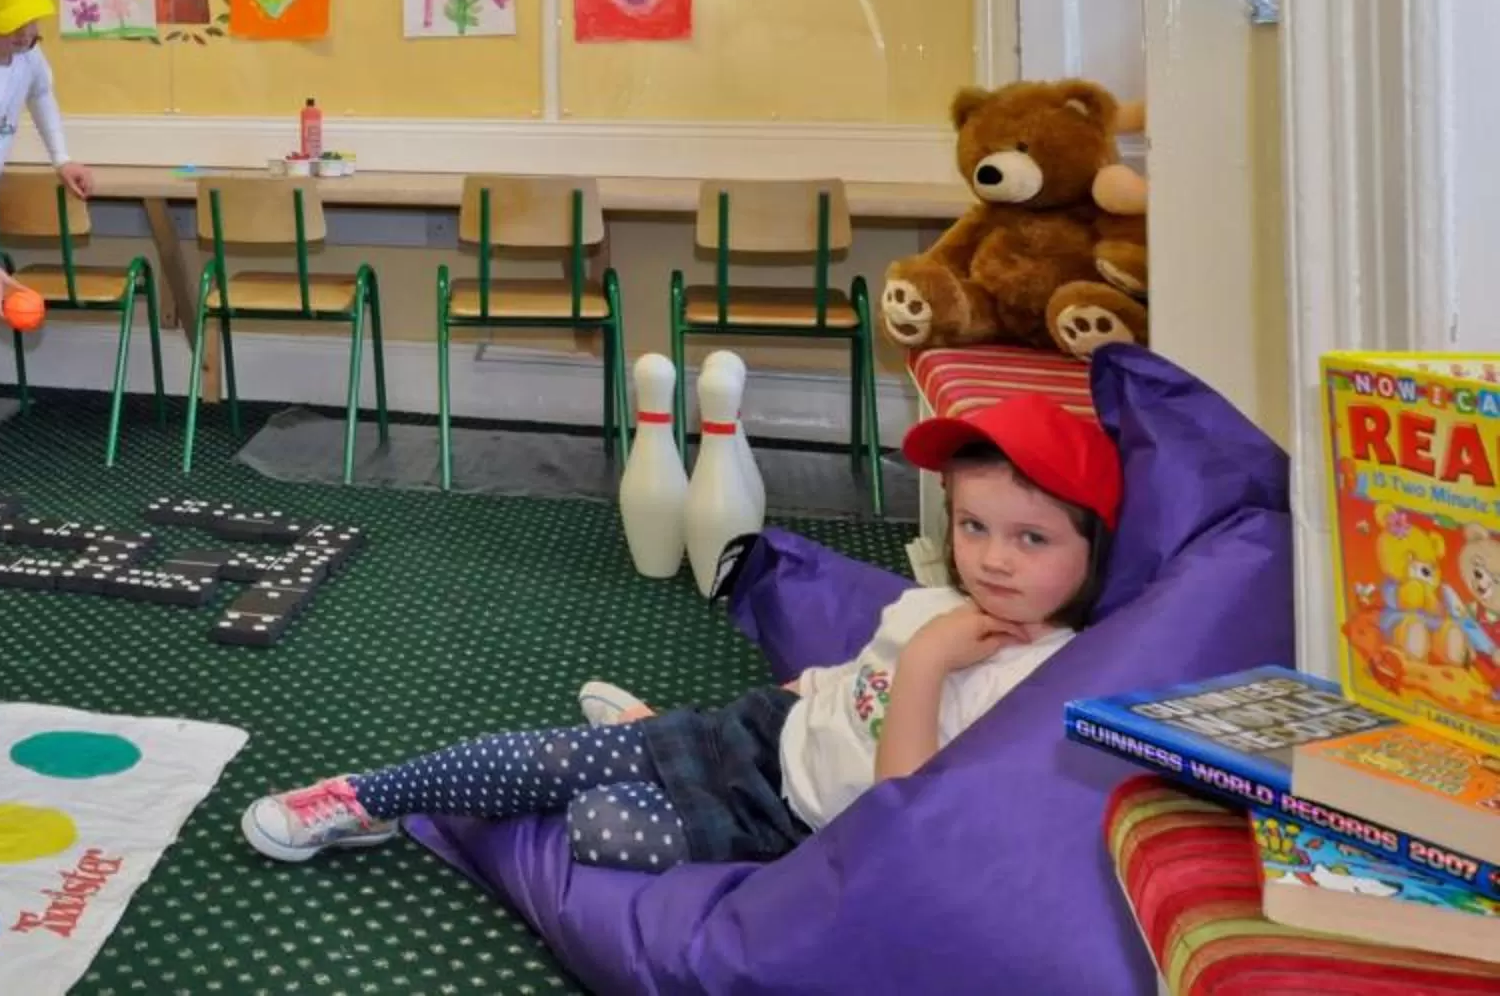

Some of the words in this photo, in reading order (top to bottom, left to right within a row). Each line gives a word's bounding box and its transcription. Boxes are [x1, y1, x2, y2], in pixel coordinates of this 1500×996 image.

[1354, 372, 1417, 403] NOW
[1431, 385, 1443, 406] I
[1348, 404, 1500, 488] REA
[1392, 474, 1426, 498] Two
[1075, 718, 1184, 773] GUINNESS
[1190, 760, 1274, 806] WORLD
[1280, 793, 1400, 853] RECORDS
[1408, 840, 1480, 882] 2007
